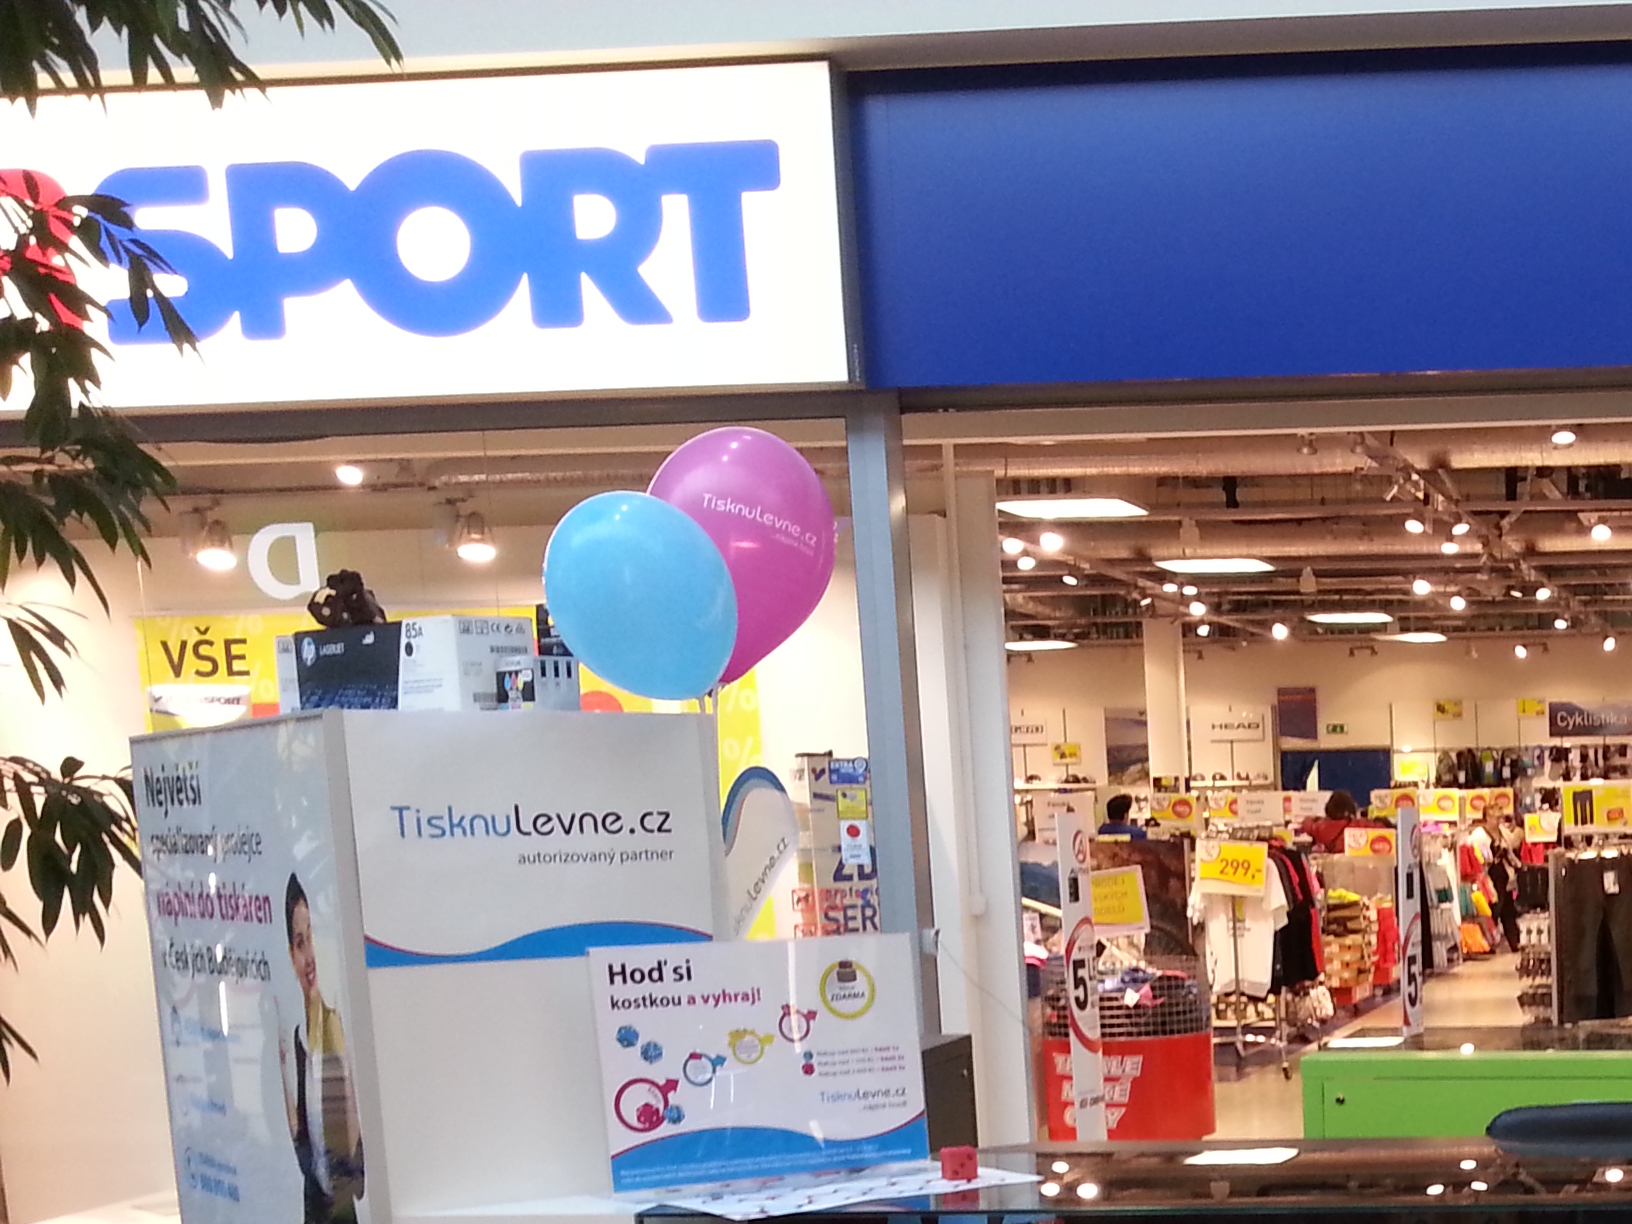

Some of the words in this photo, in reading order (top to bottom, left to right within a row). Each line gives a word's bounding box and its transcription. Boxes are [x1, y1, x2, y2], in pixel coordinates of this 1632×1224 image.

[160, 626, 251, 679] VŠE
[1210, 720, 1261, 731] HEAD
[1556, 710, 1628, 731] Cyklistika
[389, 803, 673, 839] TisknuLevne.cz
[517, 848, 616, 866] autorizovaný
[618, 848, 675, 865] partner
[1219, 857, 1264, 884] 299,-
[608, 960, 669, 986] Hoď
[672, 959, 693, 983] si
[610, 994, 682, 1011] kostkou
[687, 993, 697, 1006] a
[700, 987, 762, 1007] vyhraj!
